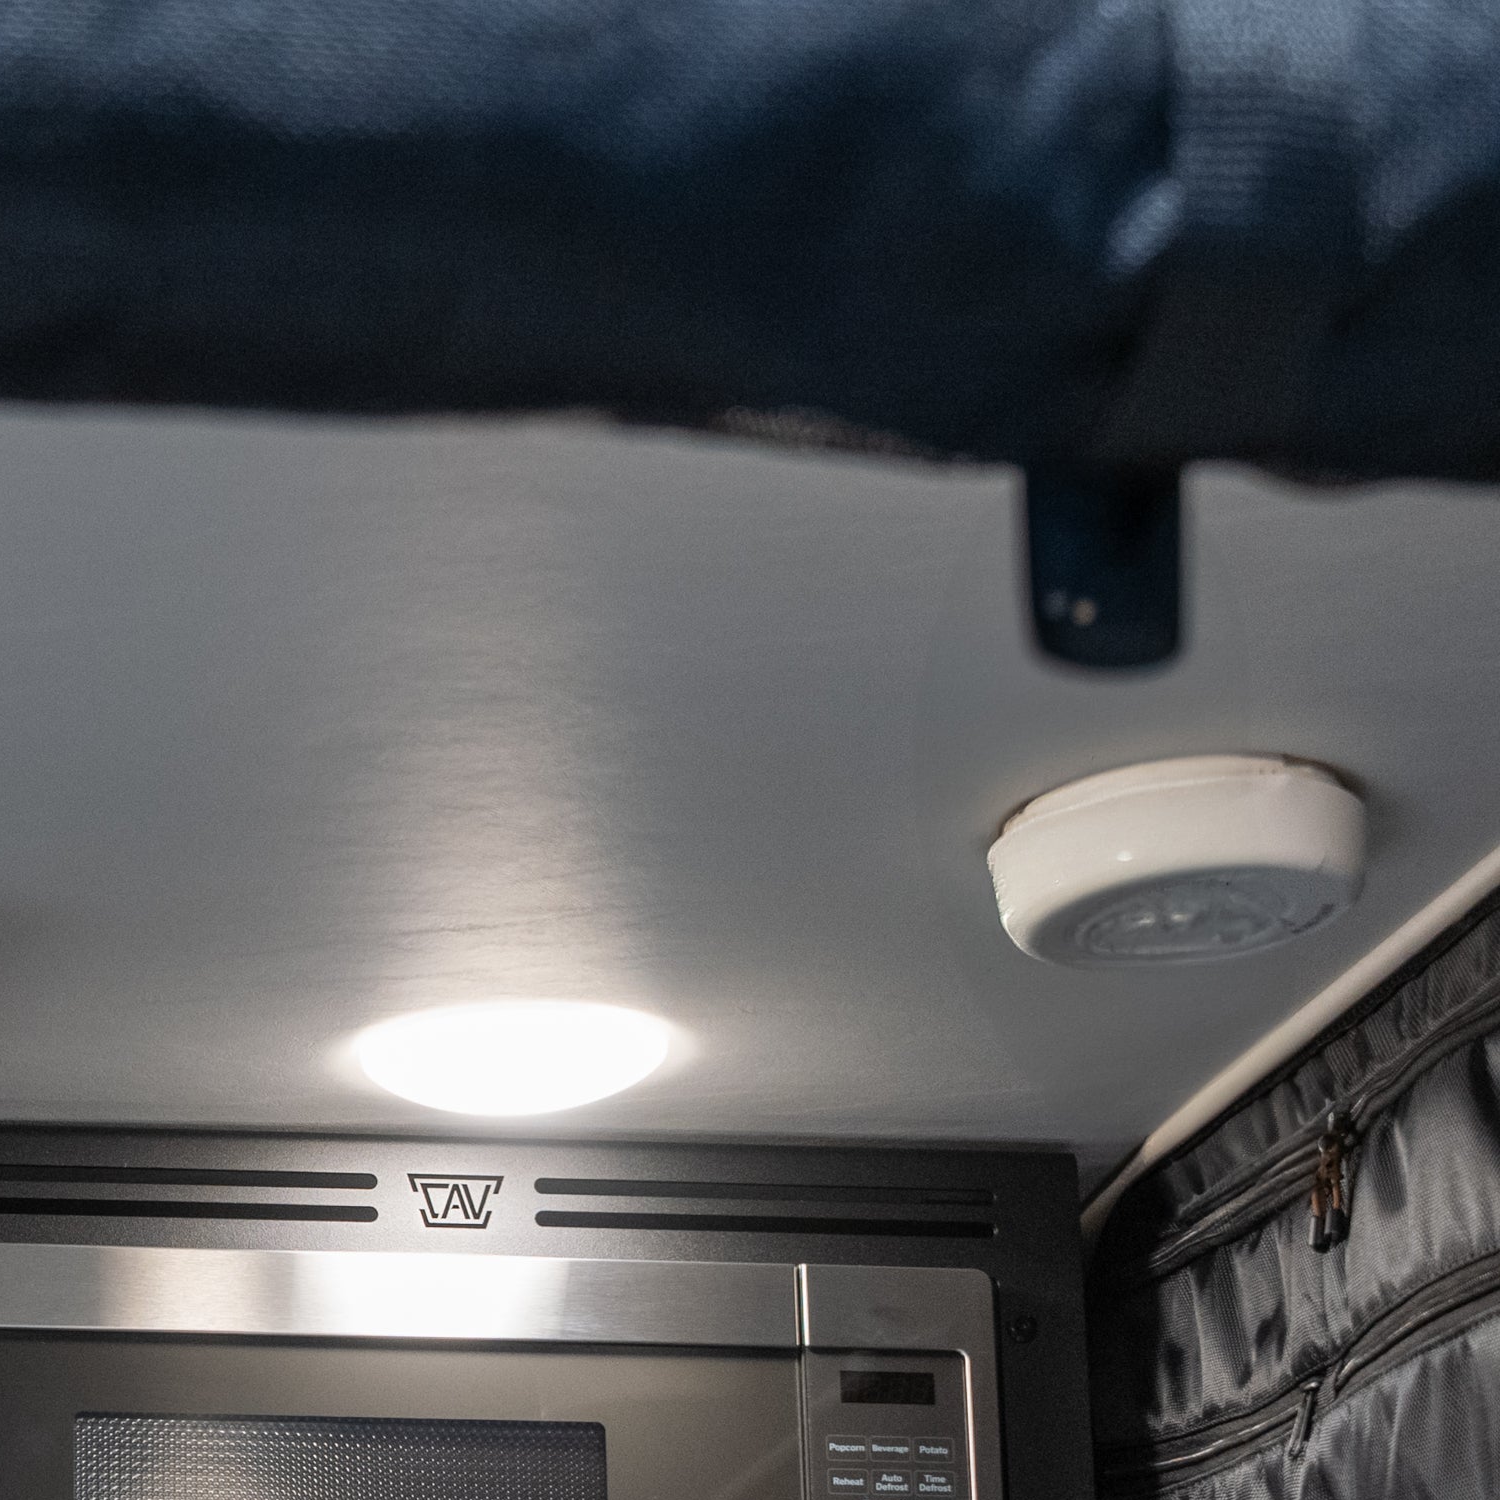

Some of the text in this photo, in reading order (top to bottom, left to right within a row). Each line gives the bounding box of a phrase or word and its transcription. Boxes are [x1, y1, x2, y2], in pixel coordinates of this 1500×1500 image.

[829, 1442, 865, 1453] Popcorn
[872, 1444, 909, 1454] Beverage
[919, 1445, 948, 1455] Potato
[832, 1476, 864, 1486] Reheat
[881, 1474, 903, 1483] Auto
[924, 1474, 946, 1483] Time
[875, 1482, 909, 1492] Defrost
[919, 1483, 952, 1493] Defrost
